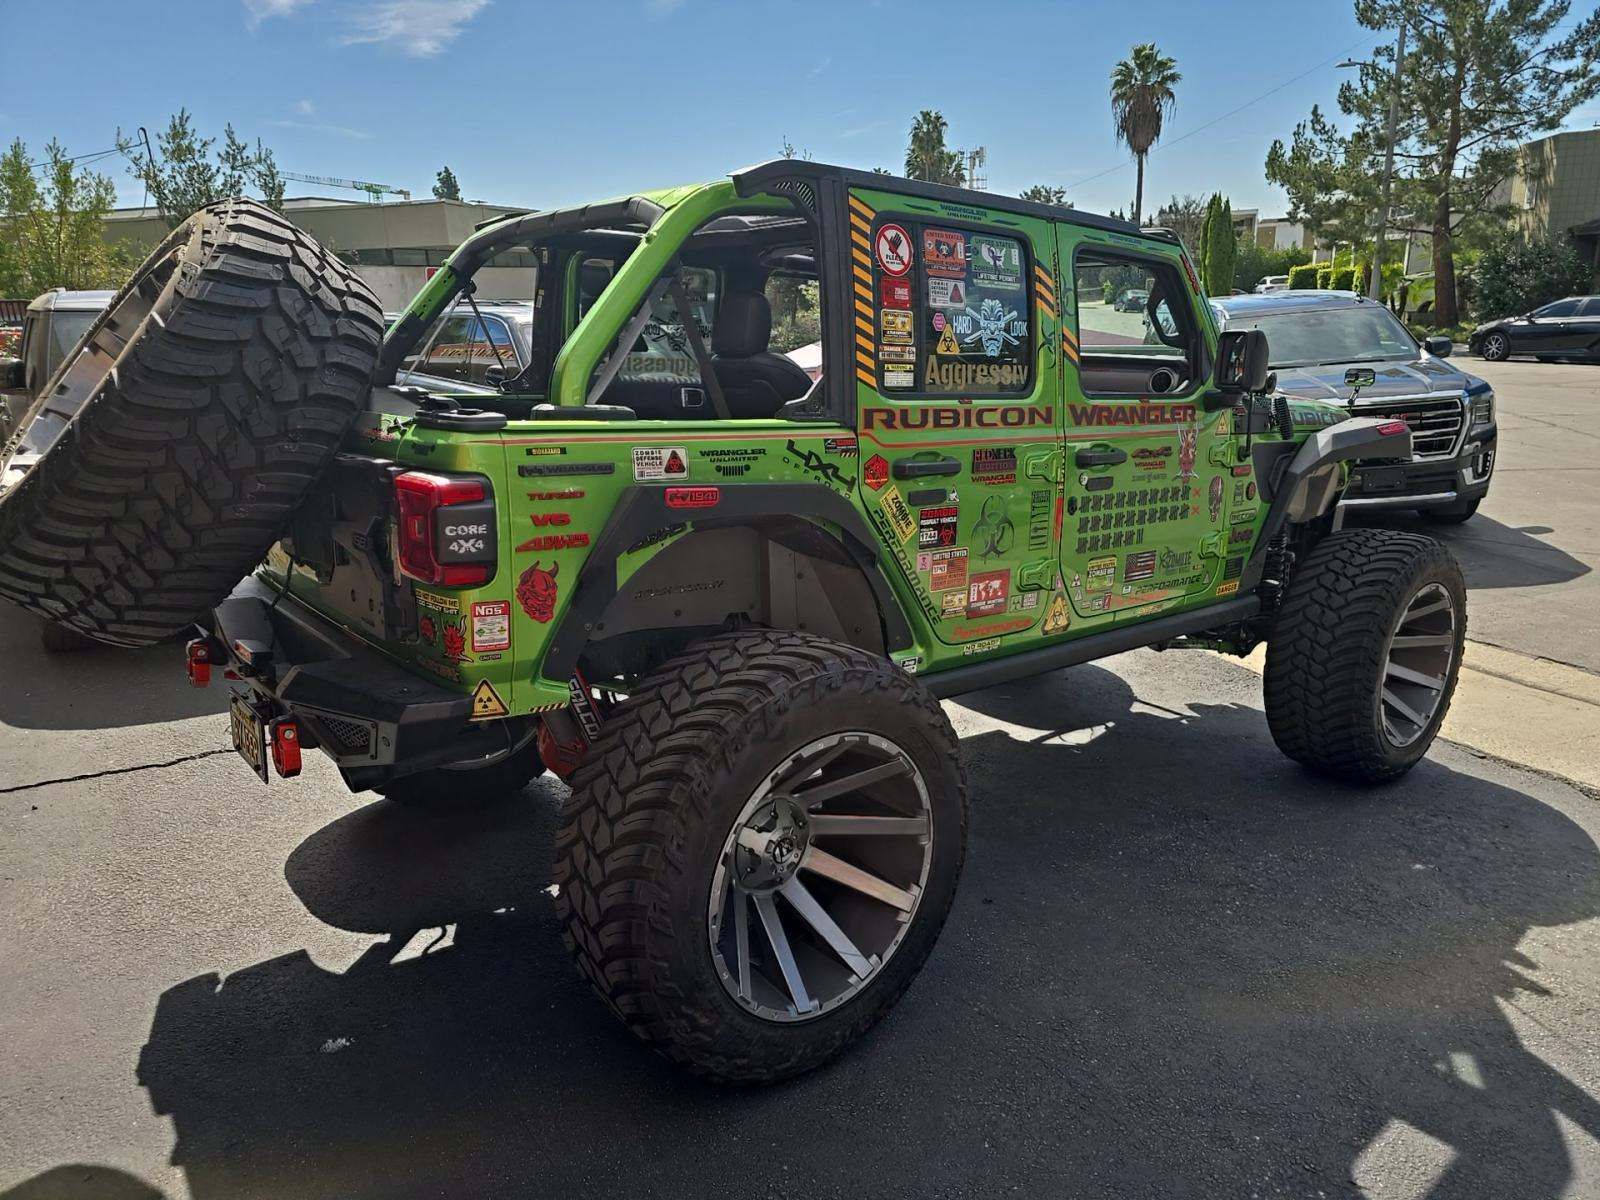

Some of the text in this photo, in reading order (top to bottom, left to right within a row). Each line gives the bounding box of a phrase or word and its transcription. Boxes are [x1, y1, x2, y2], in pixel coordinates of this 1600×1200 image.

[953, 315, 972, 334] HARD
[863, 404, 1196, 430] RUBICON WRANGLER
[699, 448, 768, 457] WRANGLER
[530, 513, 571, 527] V6
[891, 494, 913, 530] ZOMBIE
[445, 524, 487, 536] CORE
[873, 508, 942, 626] PERFORMANCE
[568, 678, 600, 740] FALCO
